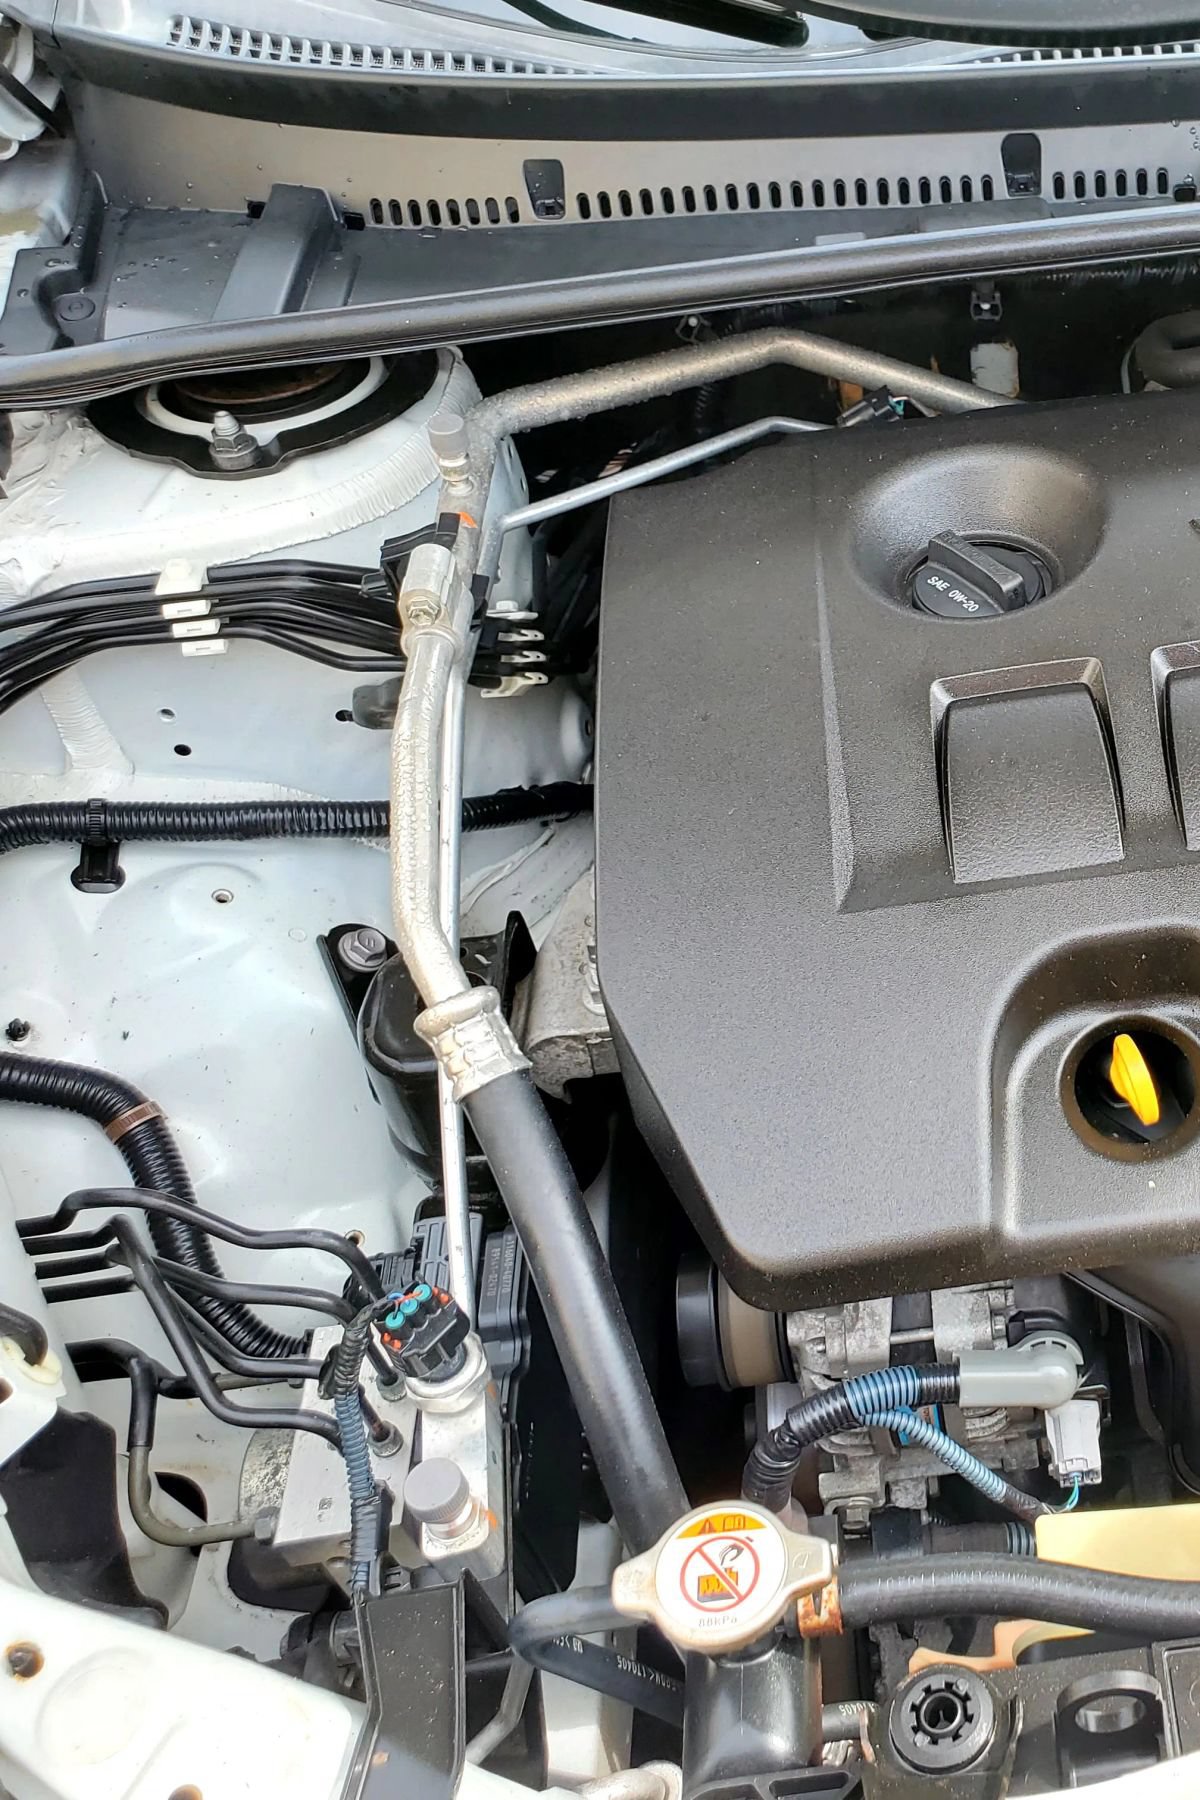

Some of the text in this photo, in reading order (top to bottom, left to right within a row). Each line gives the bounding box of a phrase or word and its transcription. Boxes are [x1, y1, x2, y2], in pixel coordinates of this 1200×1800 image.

[927, 576, 980, 613] SAE 0W-20
[698, 1614, 738, 1628] 88kPa
